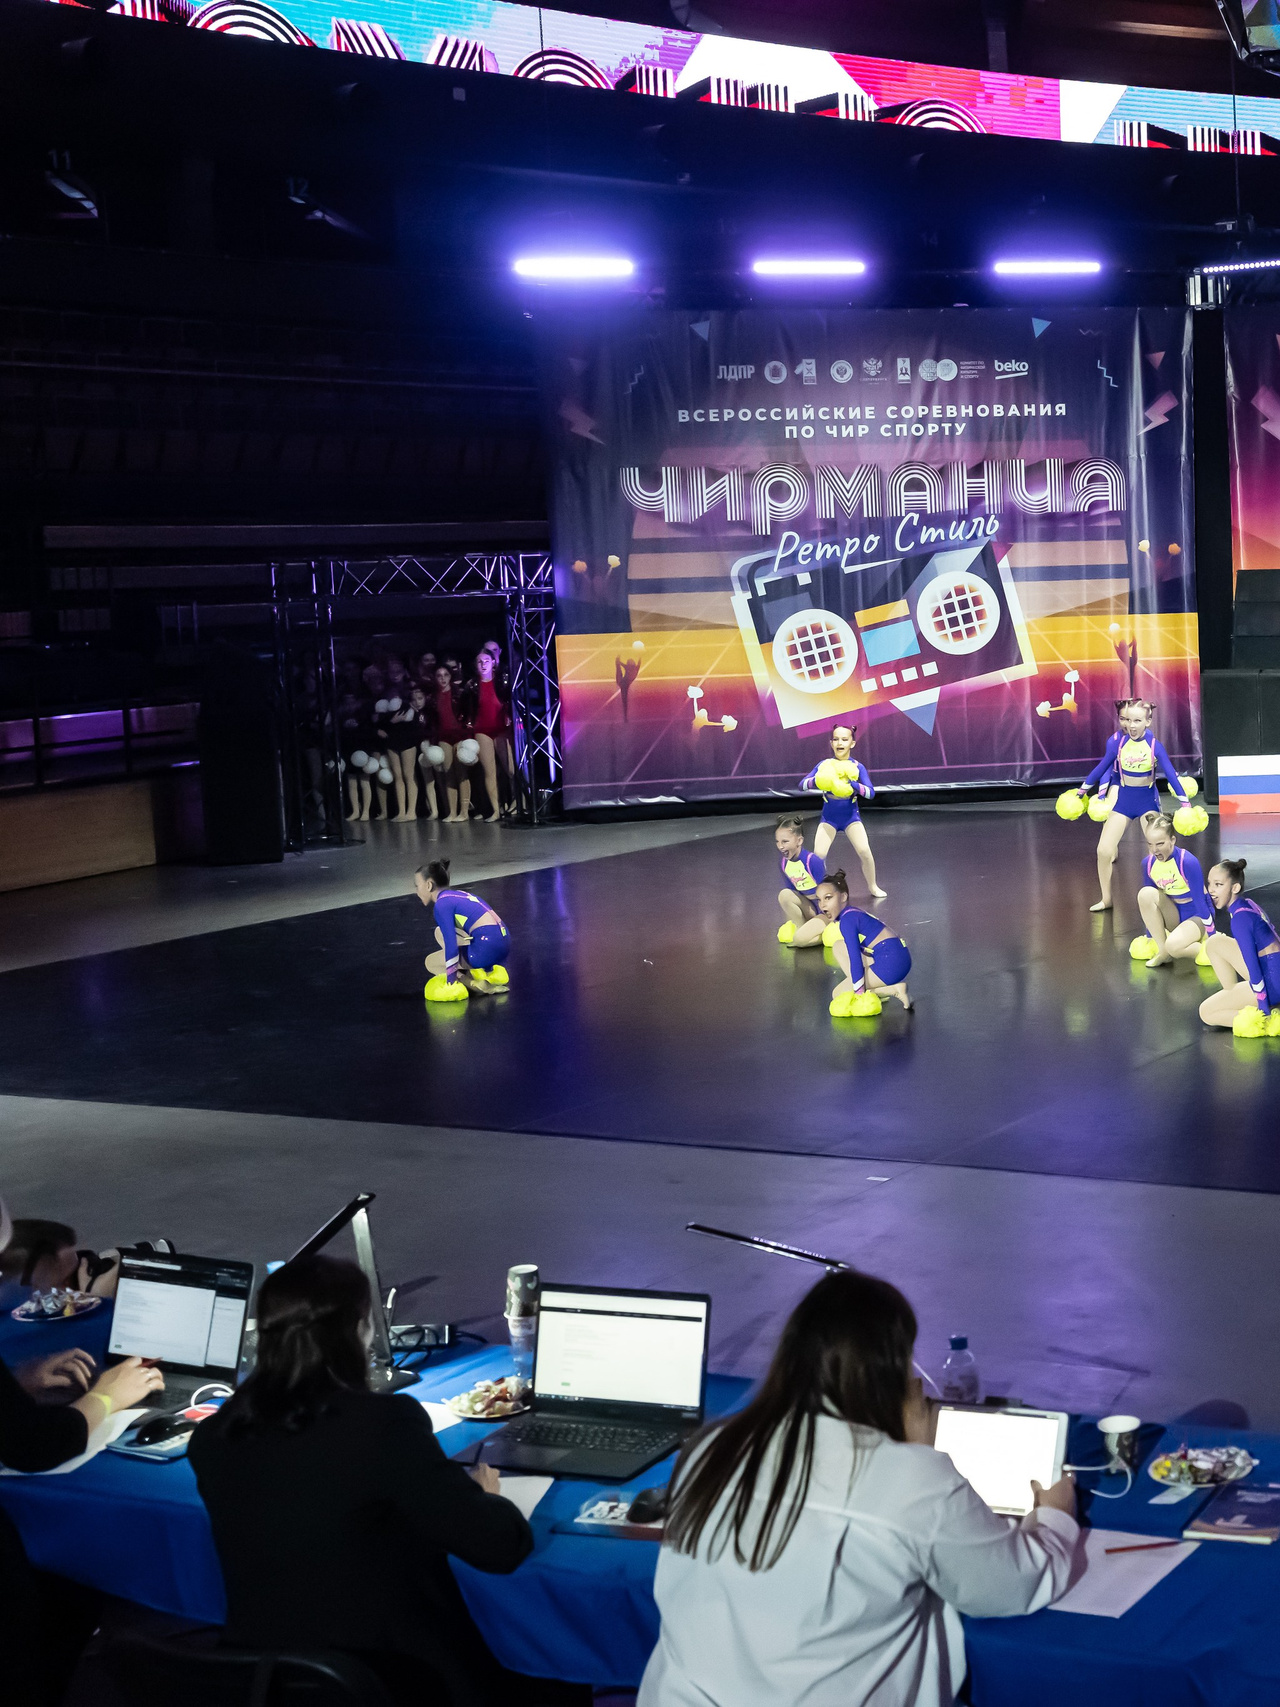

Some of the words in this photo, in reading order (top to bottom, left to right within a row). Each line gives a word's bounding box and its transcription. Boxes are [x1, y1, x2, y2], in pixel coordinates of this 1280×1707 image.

[48, 149, 71, 170] 11
[286, 177, 309, 197] 12
[717, 365, 756, 381] ЛДПР
[994, 359, 1029, 374] beko
[678, 403, 877, 422] ВСЕРОССИЙСКИЕ
[886, 403, 1067, 419] СОРЕВНОВАНИЯ
[785, 425, 815, 439] ПО
[826, 424, 870, 438] ЧИР
[880, 422, 968, 437] СПОРТУ
[773, 531, 880, 574] Ретро
[895, 512, 1000, 552] Стиль
